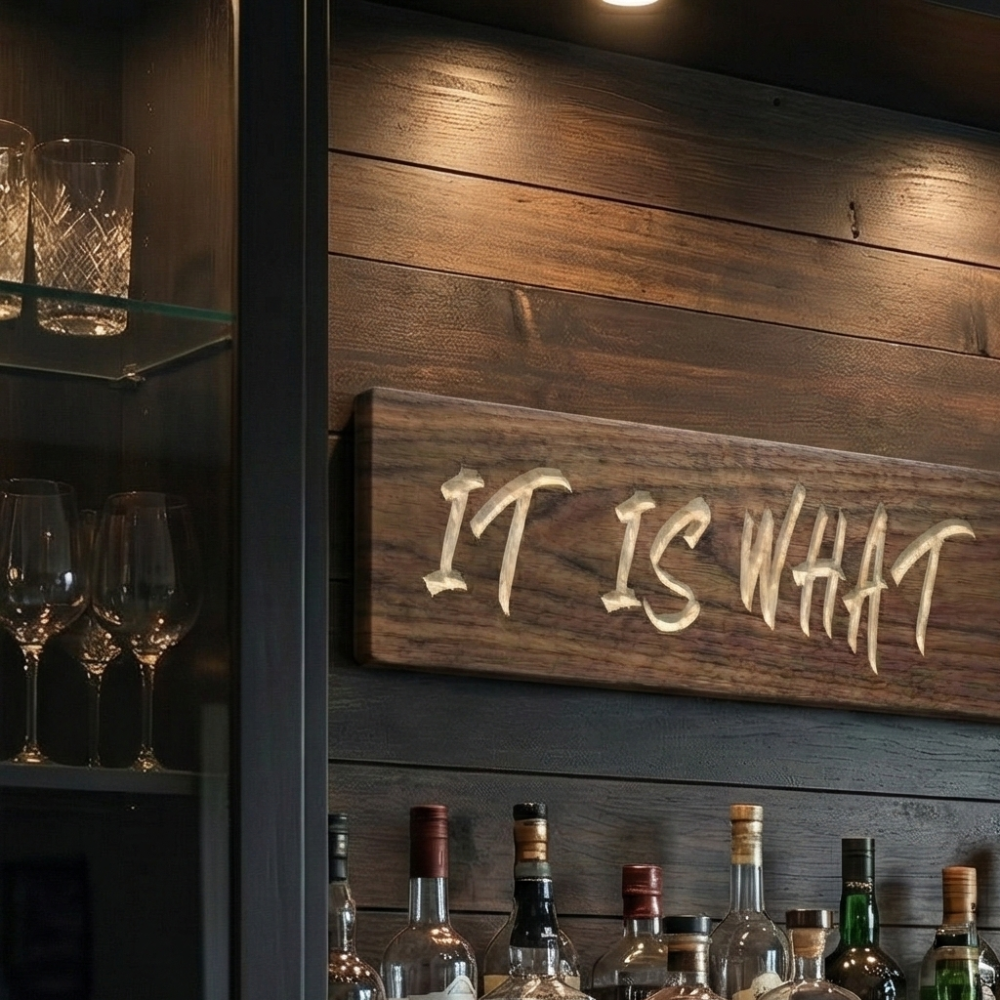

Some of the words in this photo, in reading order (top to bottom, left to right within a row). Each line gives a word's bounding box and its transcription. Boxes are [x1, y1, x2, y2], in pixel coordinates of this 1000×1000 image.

[423, 467, 572, 617] IT
[601, 490, 712, 634] IS
[740, 482, 976, 674] WHAT
